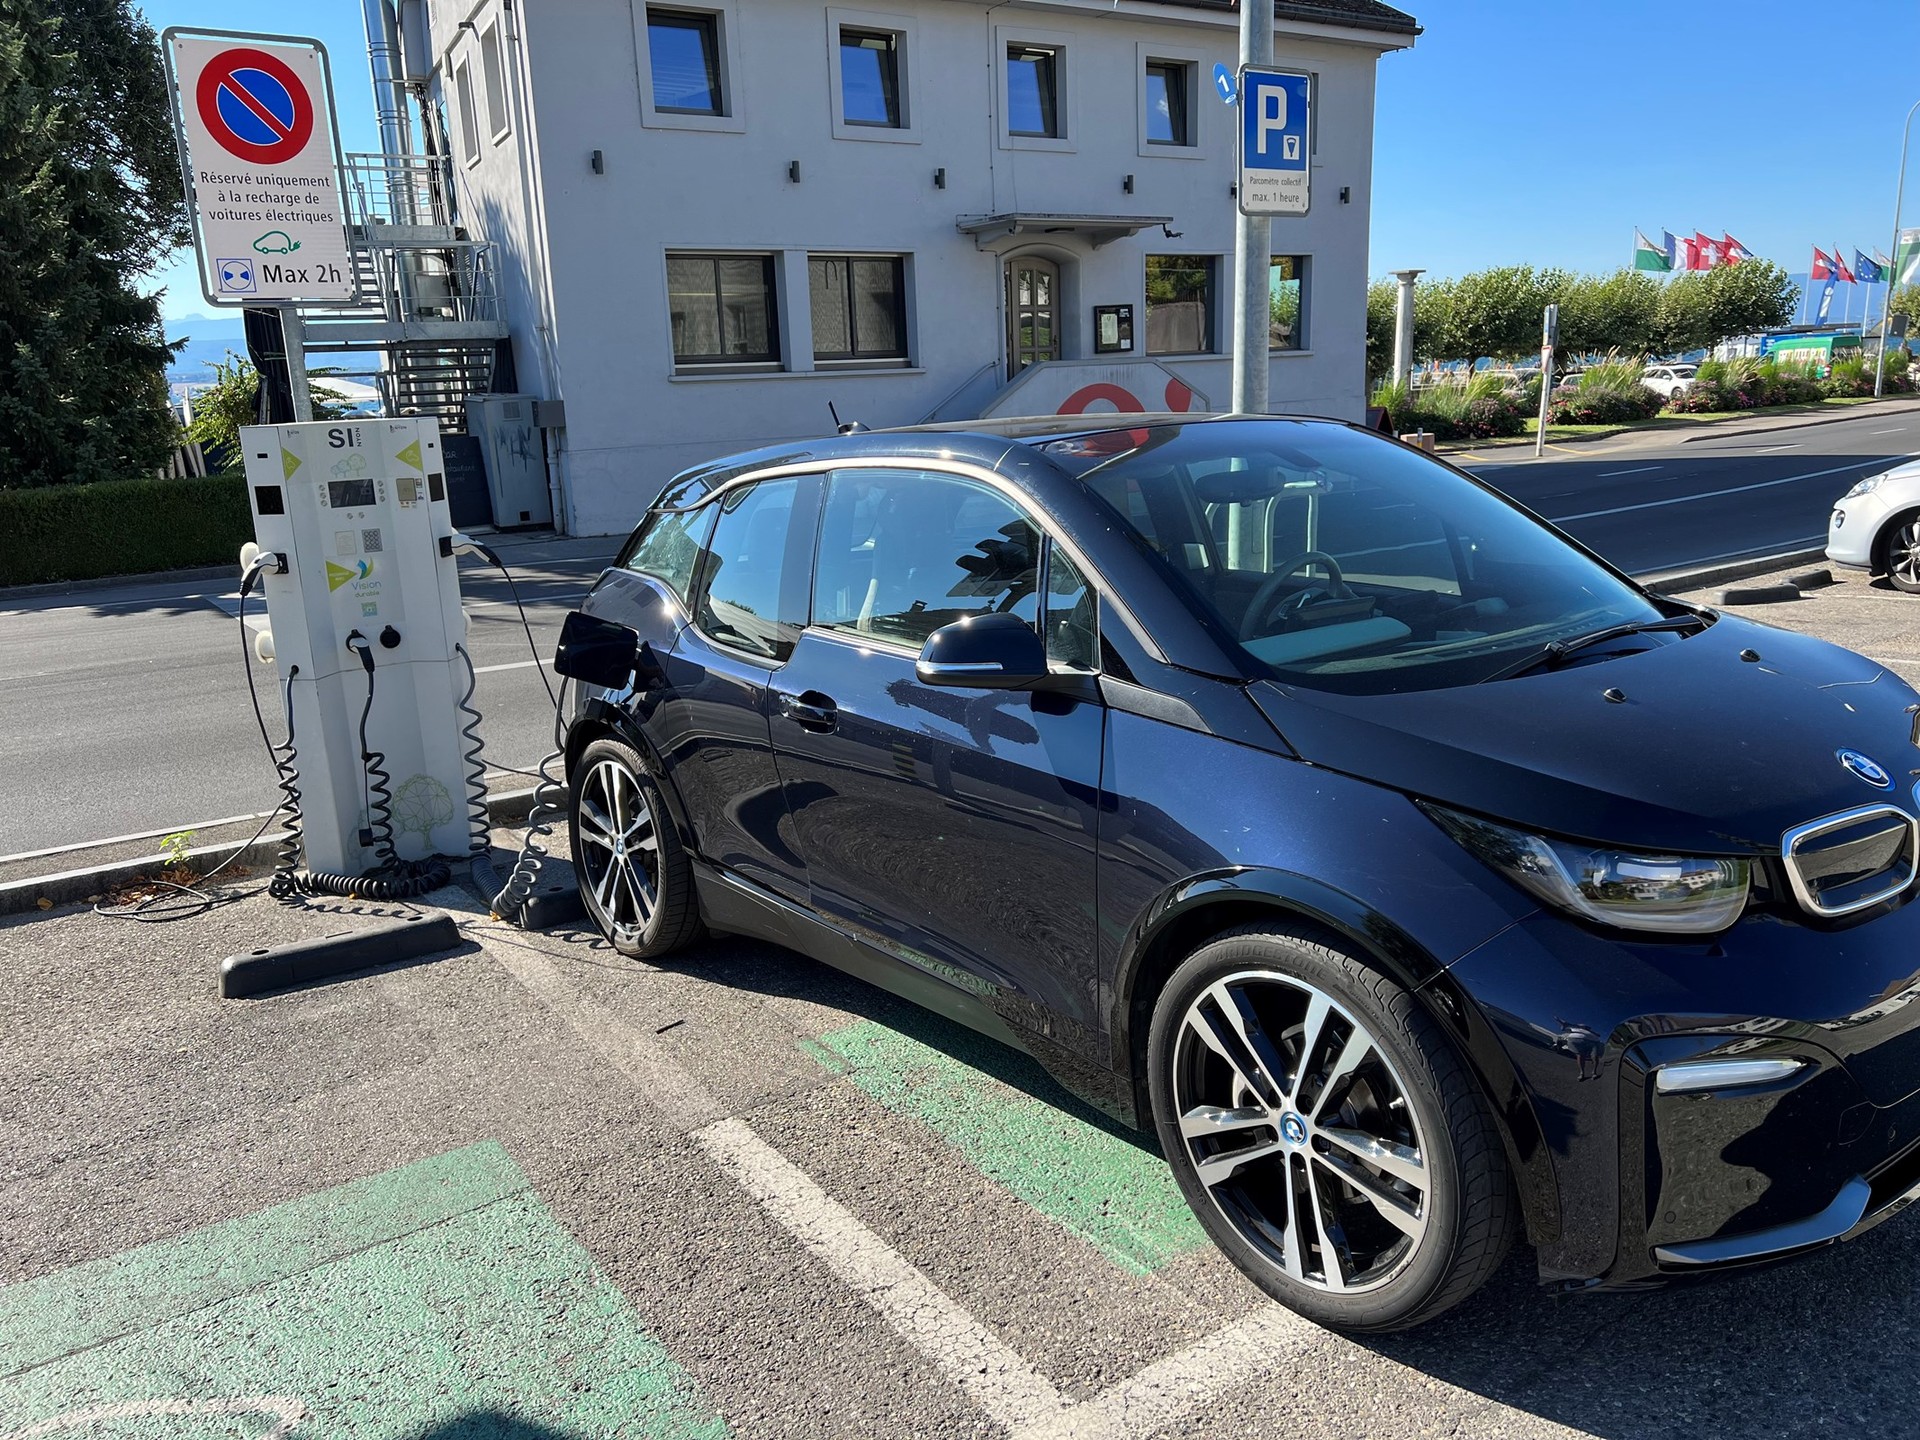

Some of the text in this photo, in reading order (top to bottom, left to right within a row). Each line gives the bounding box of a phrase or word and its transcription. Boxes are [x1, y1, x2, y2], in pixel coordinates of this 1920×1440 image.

[1218, 74, 1230, 93] 1
[1257, 84, 1288, 154] P
[200, 171, 330, 189] Réservé uniquement
[1249, 176, 1302, 187] Parcomètre collectif
[217, 190, 320, 206] à la recharge de
[1252, 192, 1300, 203] max. 1 heure
[208, 209, 334, 225] voitures électriques
[262, 263, 342, 284] Max 2h
[328, 427, 354, 449] SI
[351, 580, 382, 590] Vision
